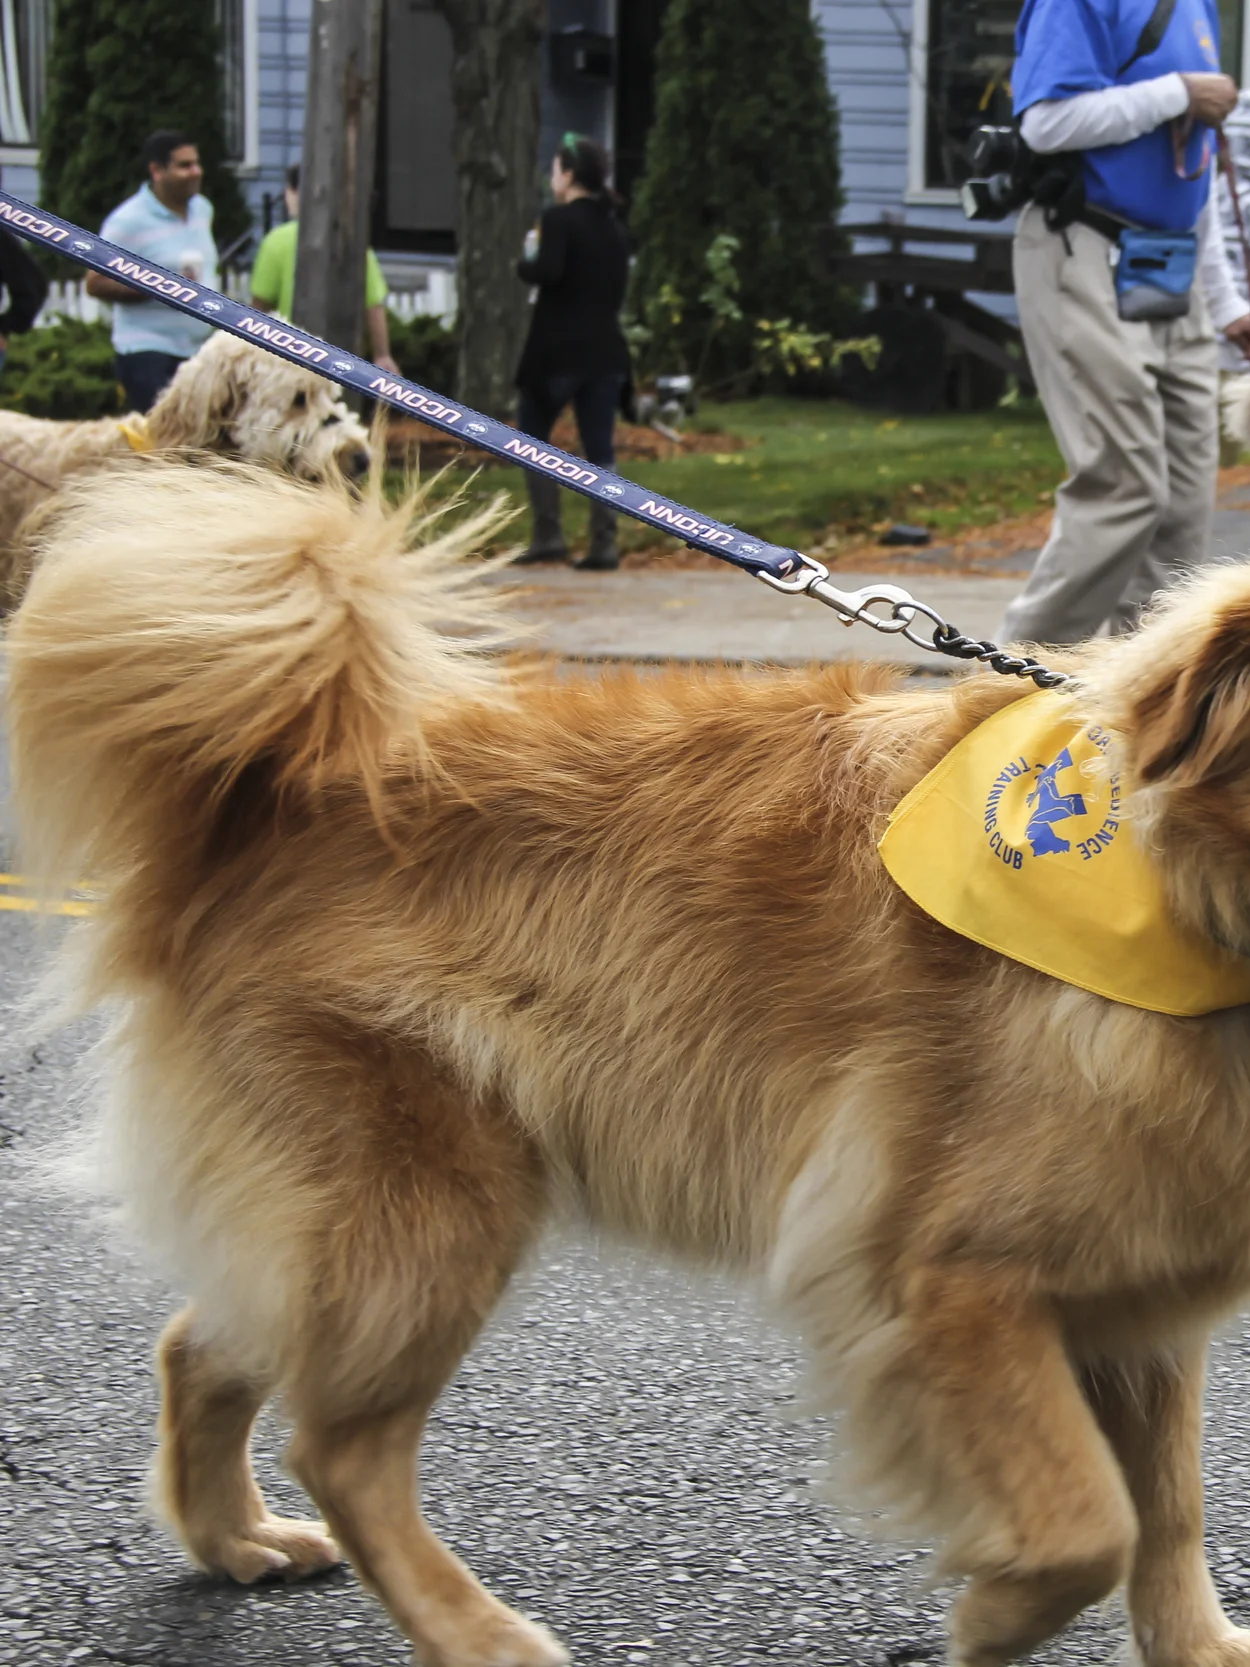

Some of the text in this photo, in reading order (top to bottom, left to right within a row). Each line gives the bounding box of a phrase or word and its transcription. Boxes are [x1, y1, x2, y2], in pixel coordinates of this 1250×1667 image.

[0, 202, 70, 242] UCON
[107, 256, 199, 302] UCONN
[238, 317, 329, 363] UCONN
[369, 377, 462, 424] UCONN
[504, 438, 599, 486] UCONN
[638, 499, 735, 545] UCONN
[984, 757, 1031, 869] TRAINING CLUB
[1076, 772, 1121, 860] BEDIENCE
